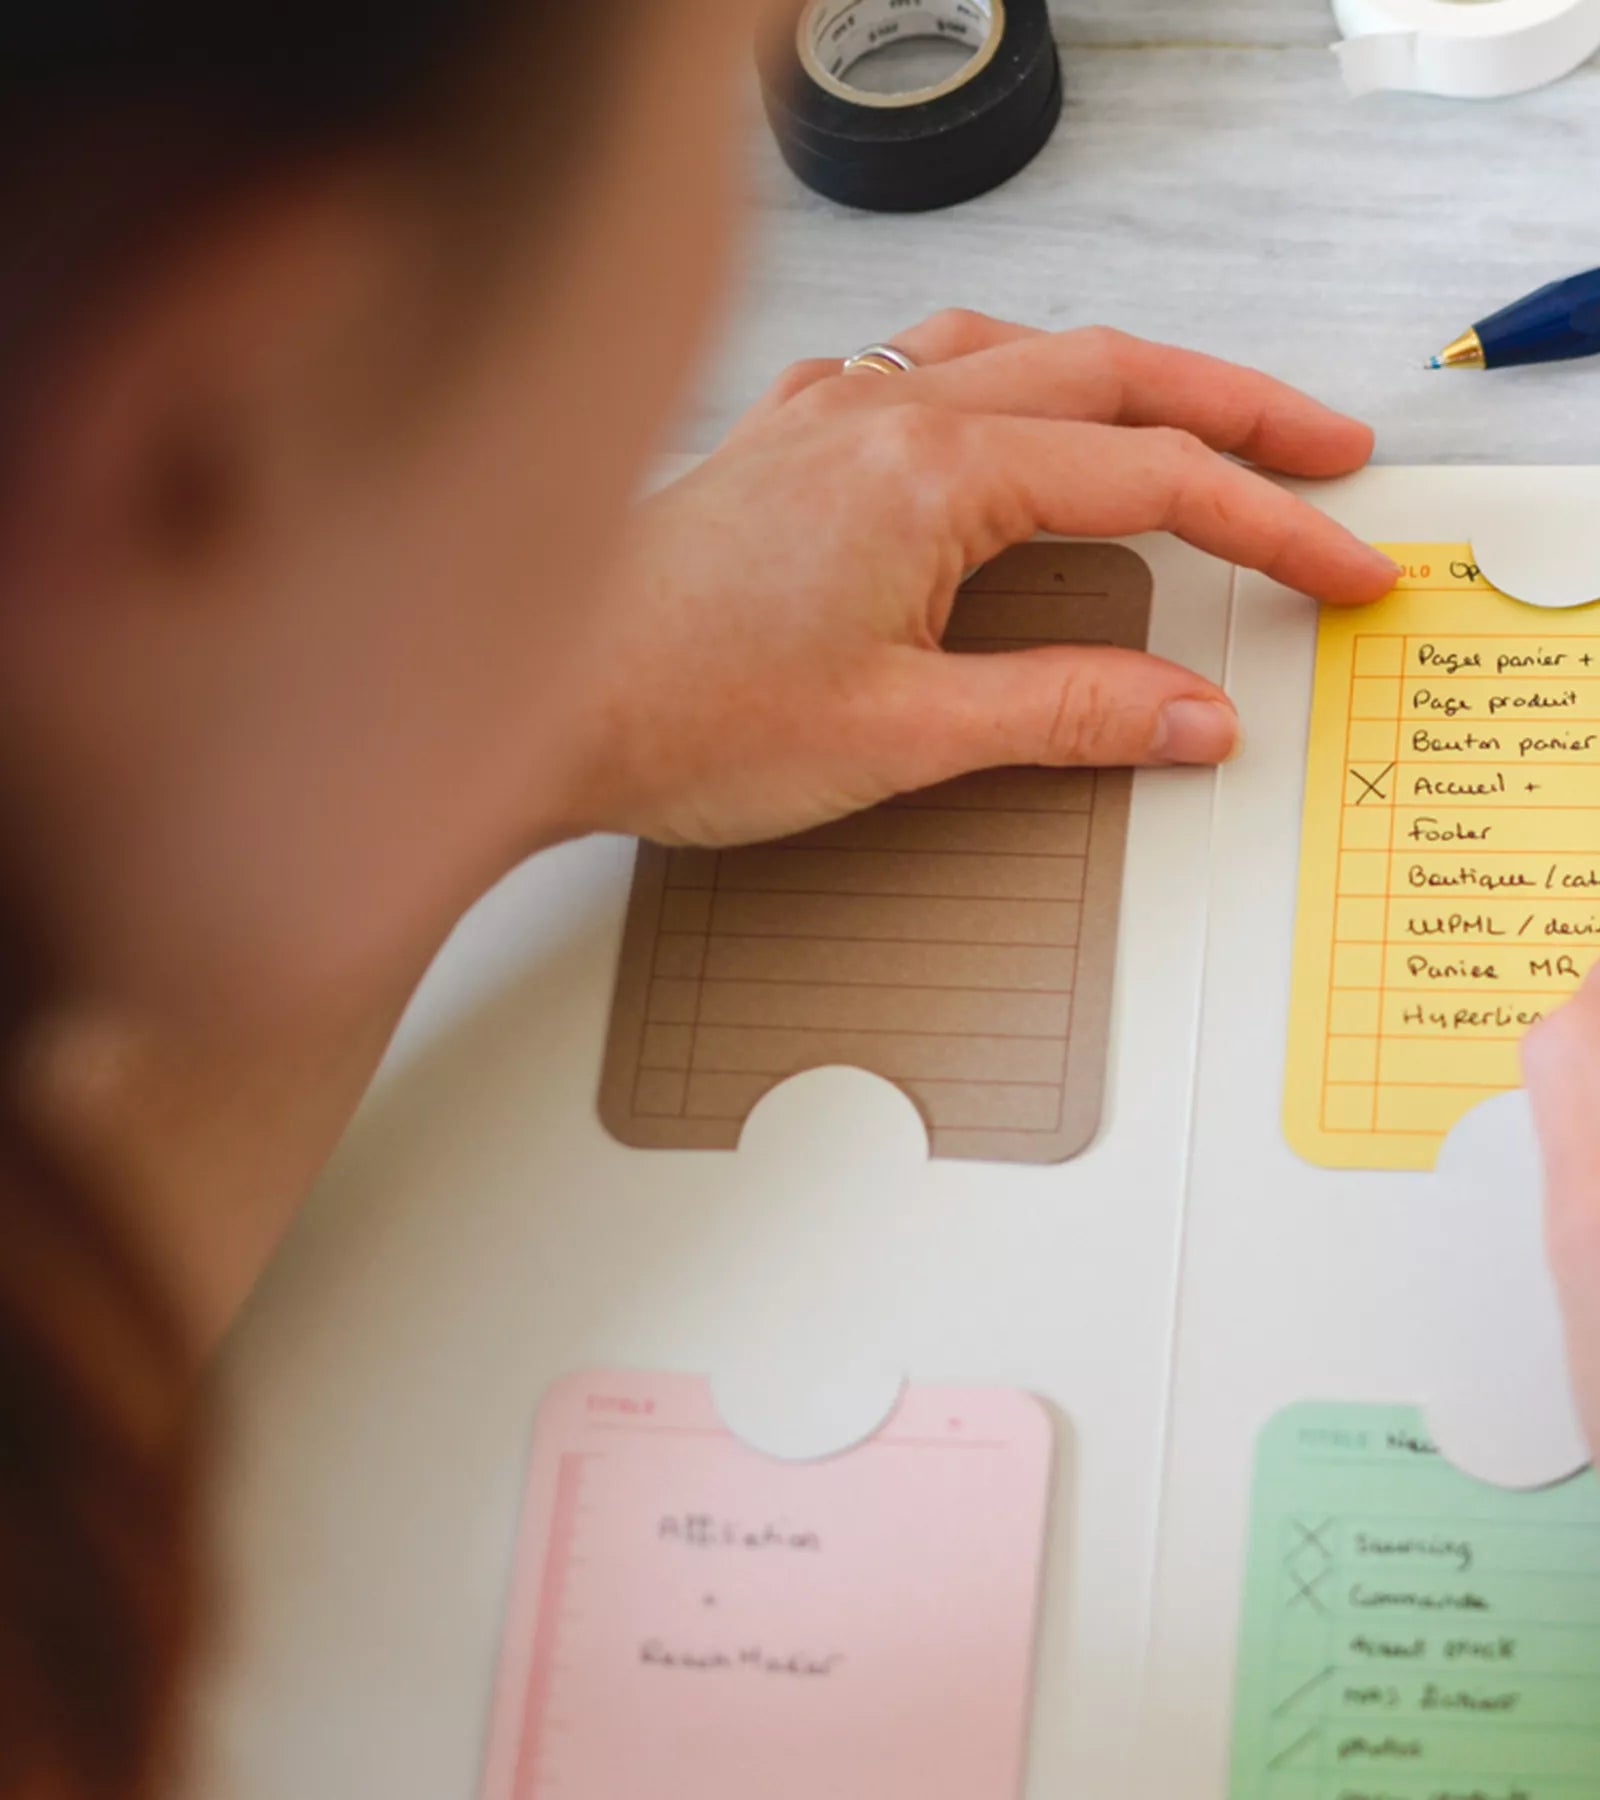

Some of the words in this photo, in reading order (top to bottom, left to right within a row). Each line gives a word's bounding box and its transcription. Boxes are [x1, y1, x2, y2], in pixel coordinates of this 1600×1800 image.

[1496, 647, 1568, 673] panier
[1489, 691, 1578, 715] produit
[1519, 732, 1598, 757] panier
[1413, 772, 1505, 796] Accueil
[1408, 863, 1537, 890] Boutique
[1529, 956, 1580, 978] MR
